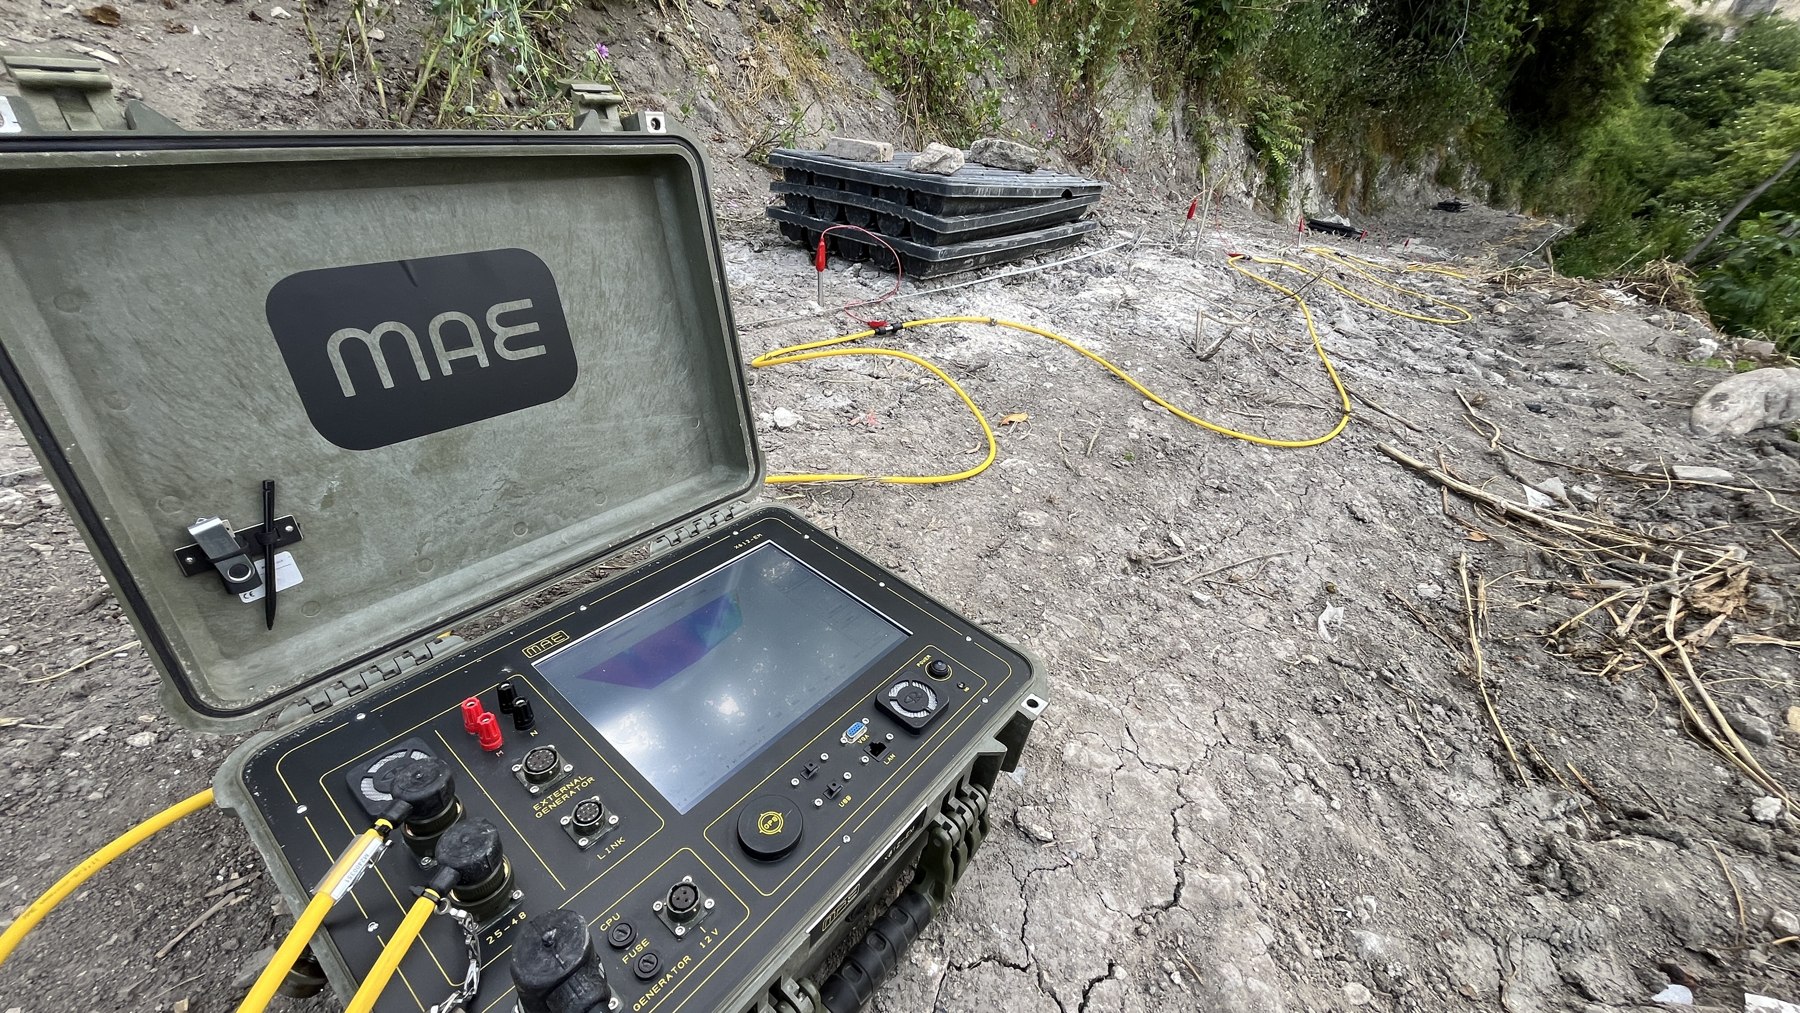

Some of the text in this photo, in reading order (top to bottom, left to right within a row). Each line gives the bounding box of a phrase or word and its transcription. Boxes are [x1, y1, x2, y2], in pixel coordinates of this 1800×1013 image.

[327, 298, 547, 398] MAE
[526, 632, 566, 656] MAE
[857, 734, 870, 744] VGA
[883, 753, 896, 765] LAN
[532, 775, 587, 812] EXTERNAL
[535, 776, 595, 819] GENERATOR
[838, 794, 852, 808] USB
[596, 836, 626, 860] LINK
[486, 911, 527, 945] 25-48
[600, 912, 621, 932] CPU
[621, 937, 650, 965] FUSE
[632, 954, 692, 1012] GENERATOR
